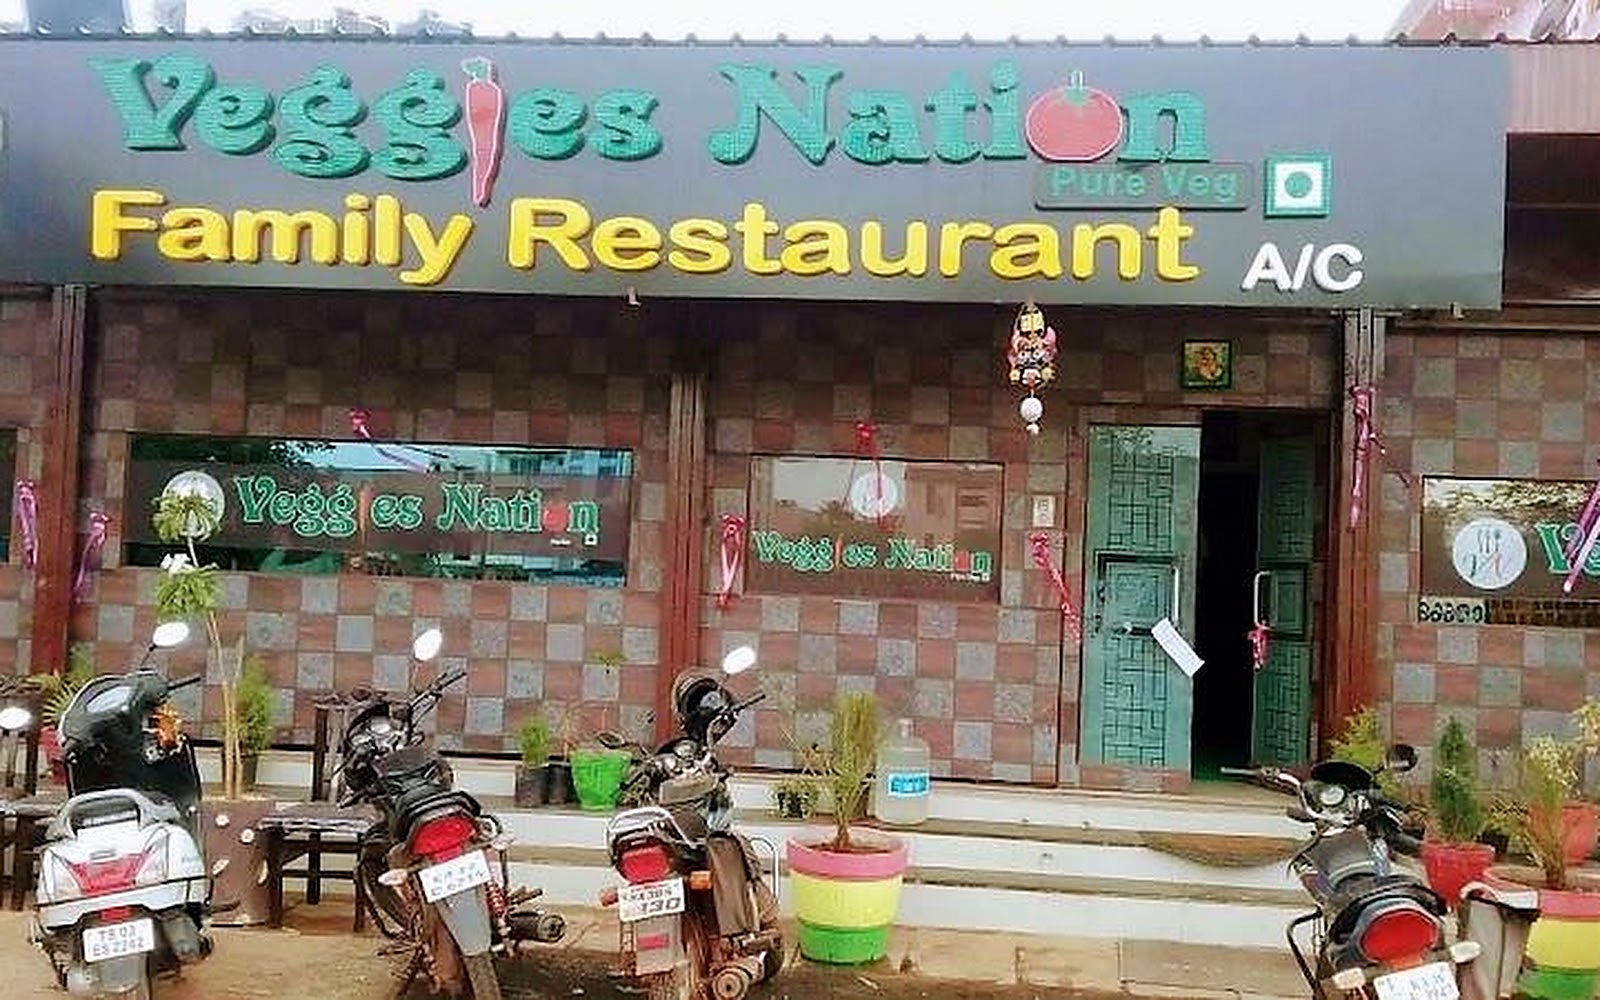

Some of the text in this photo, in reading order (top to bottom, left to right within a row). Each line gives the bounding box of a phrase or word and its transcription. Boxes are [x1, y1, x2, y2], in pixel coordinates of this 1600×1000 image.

[1051, 165, 1240, 203] Pure Veg
[91, 188, 1200, 285] Family Restaurant
[1241, 241, 1364, 293] A/C
